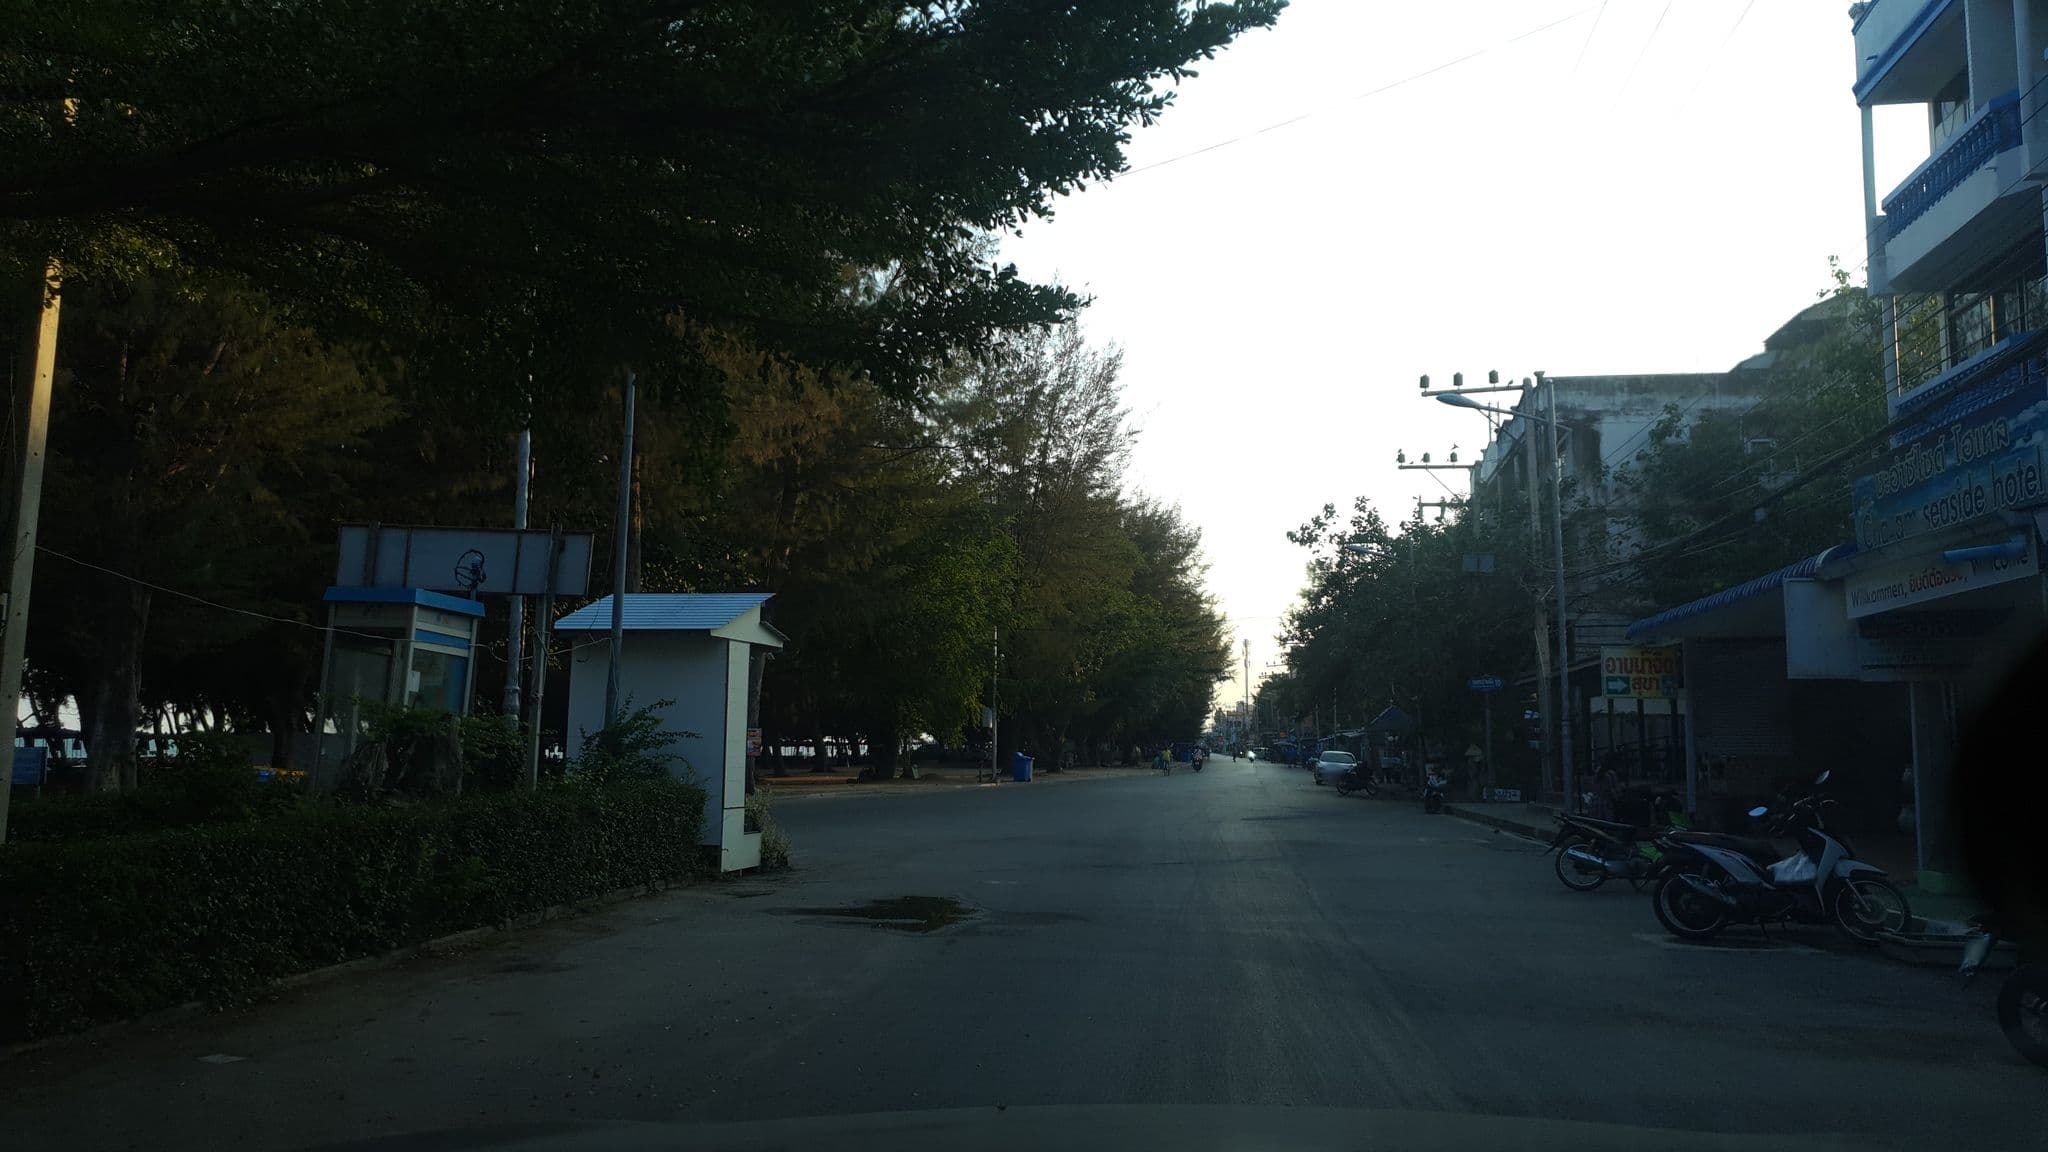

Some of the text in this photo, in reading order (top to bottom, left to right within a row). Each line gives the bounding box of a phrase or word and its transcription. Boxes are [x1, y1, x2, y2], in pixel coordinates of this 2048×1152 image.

[1923, 471, 1986, 529] seaside
[1990, 445, 2046, 508] hotel
[1851, 583, 1909, 608] Wommen,
